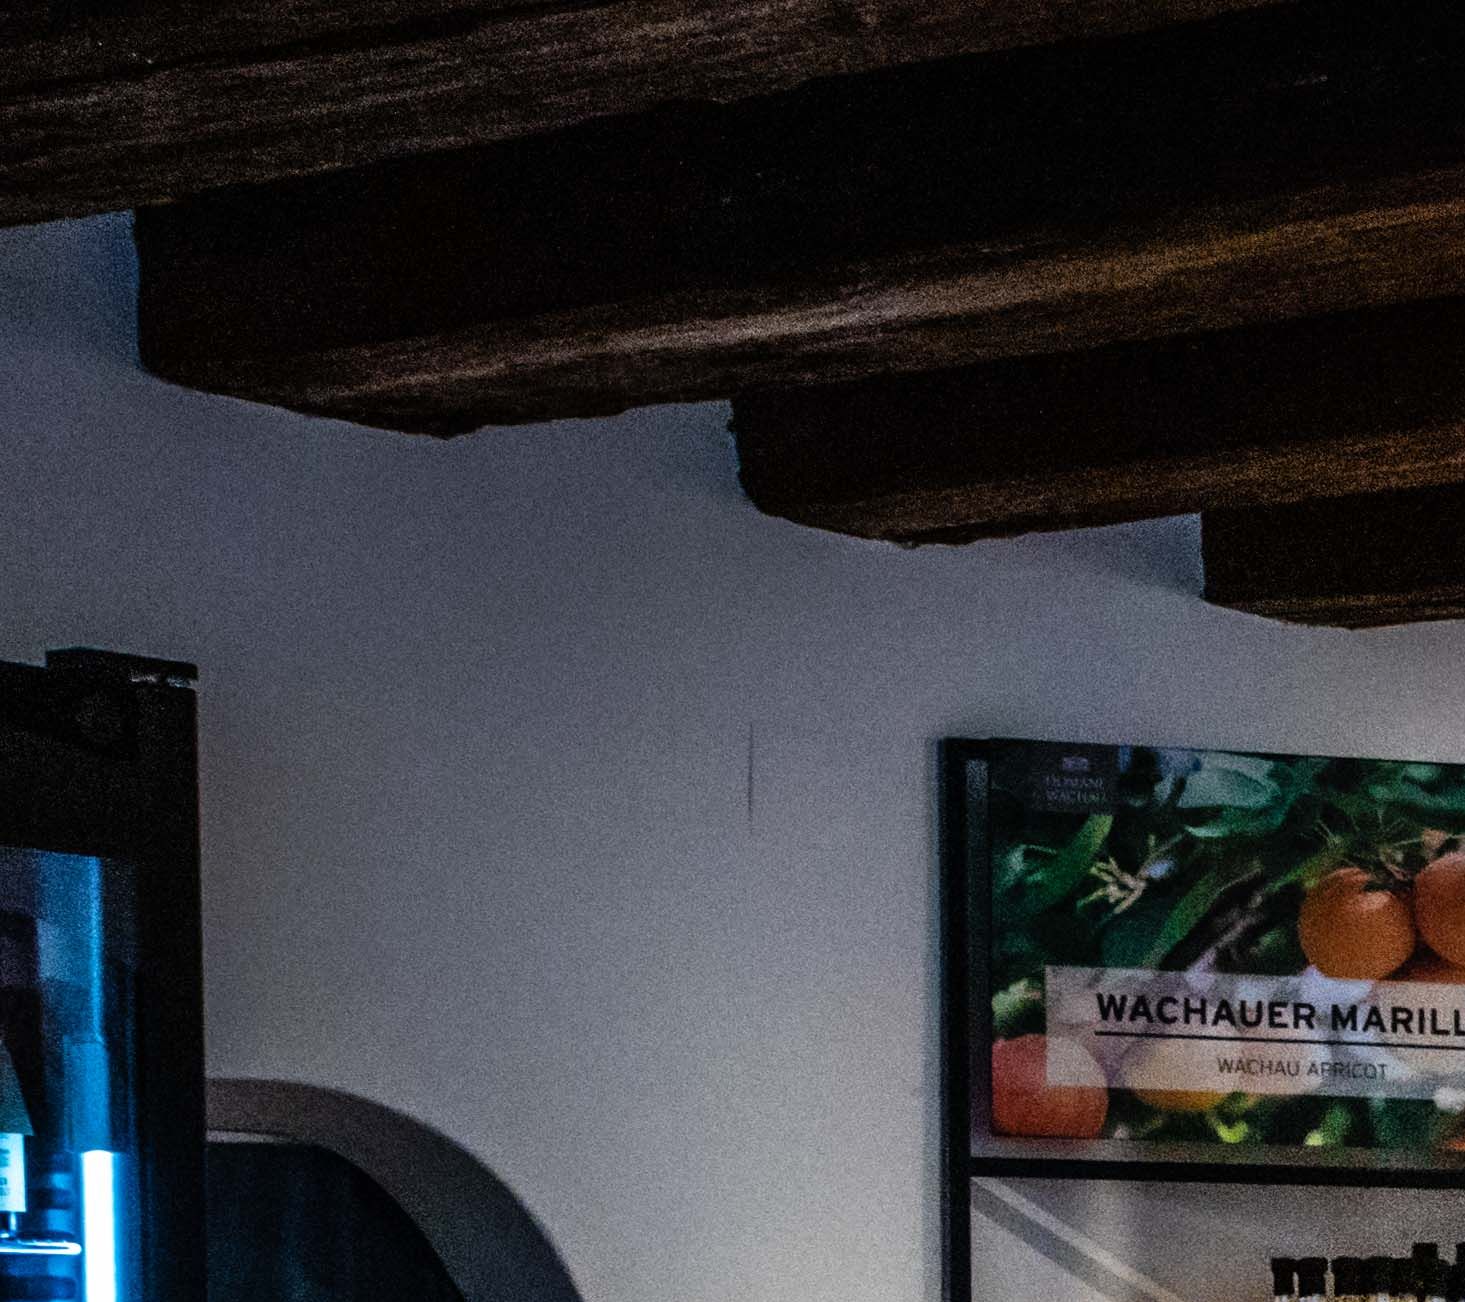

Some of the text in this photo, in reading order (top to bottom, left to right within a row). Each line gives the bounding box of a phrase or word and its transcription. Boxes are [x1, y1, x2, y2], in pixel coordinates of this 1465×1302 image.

[1095, 993, 1317, 1030] WACHAUER
[1217, 1056, 1389, 1081] WACHAU APRICOT
